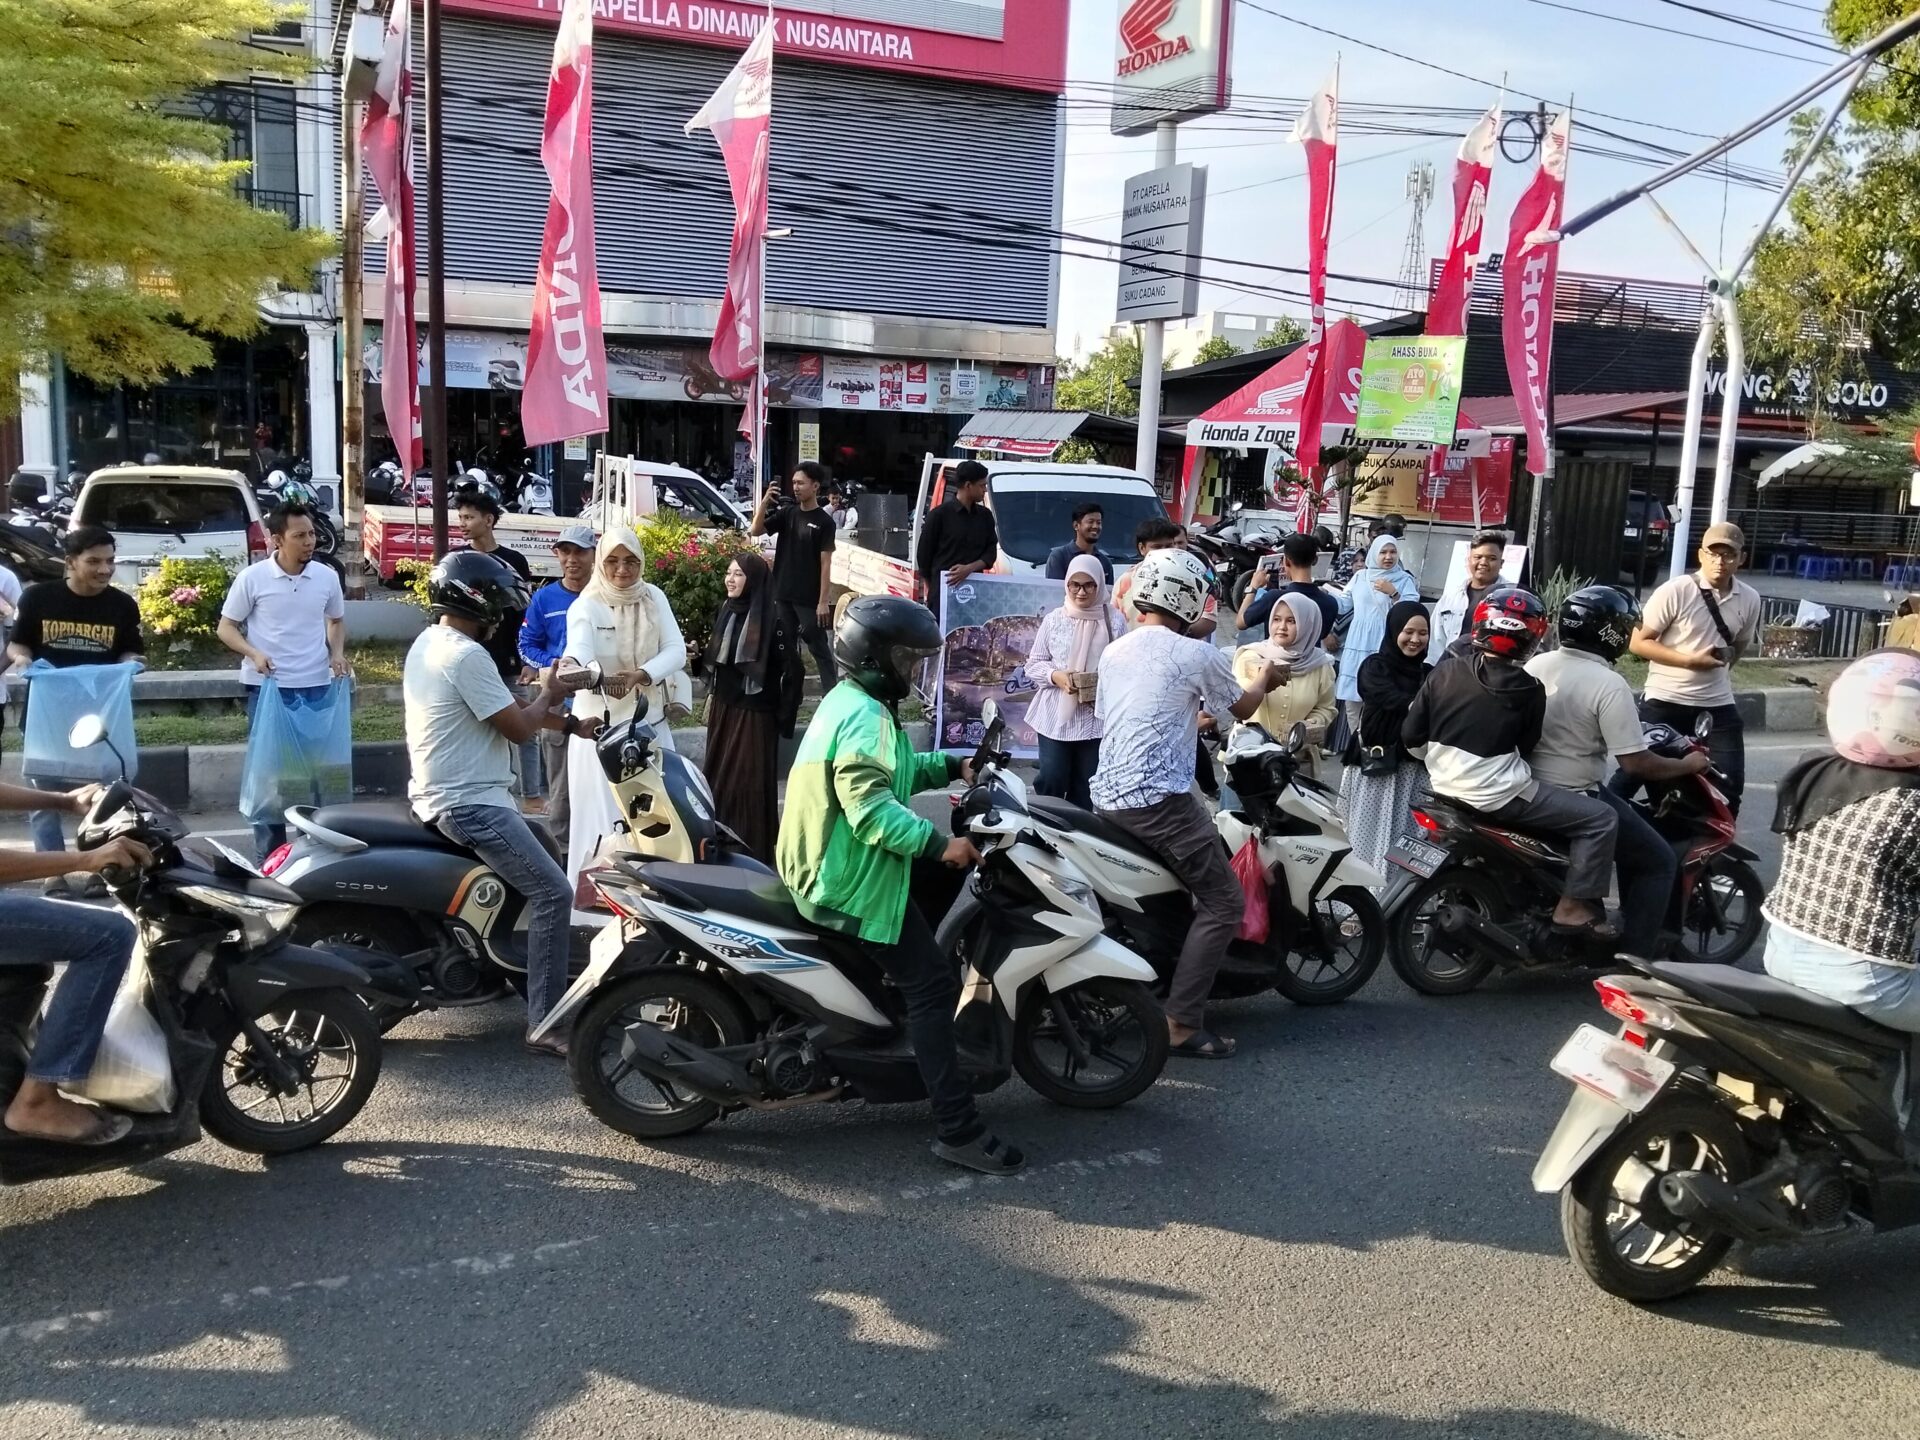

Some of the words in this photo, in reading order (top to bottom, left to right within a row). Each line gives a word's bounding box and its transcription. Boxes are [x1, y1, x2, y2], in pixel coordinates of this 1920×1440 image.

[591, 0, 681, 28] APELLA
[687, 5, 780, 42] DINAMIK
[786, 19, 913, 60] NUSANTARA
[1117, 36, 1190, 77] HONDA
[1132, 189, 1140, 202] PT
[1140, 182, 1170, 200] CAPELLA
[1142, 195, 1187, 214] NUSANTARA
[1124, 290, 1139, 302] SUKU
[1138, 285, 1166, 300] CADANG
[445, 334, 491, 344] COOPY
[1391, 346, 1416, 358] AHASS
[1418, 346, 1438, 357] BUKA
[1243, 407, 1293, 415] HONDA
[1200, 424, 1249, 442] Honda
[1254, 424, 1296, 444] Zone
[1363, 458, 1388, 469] BUKA
[1500, 619, 1519, 628] GM
[1296, 844, 1324, 857] HONDA
